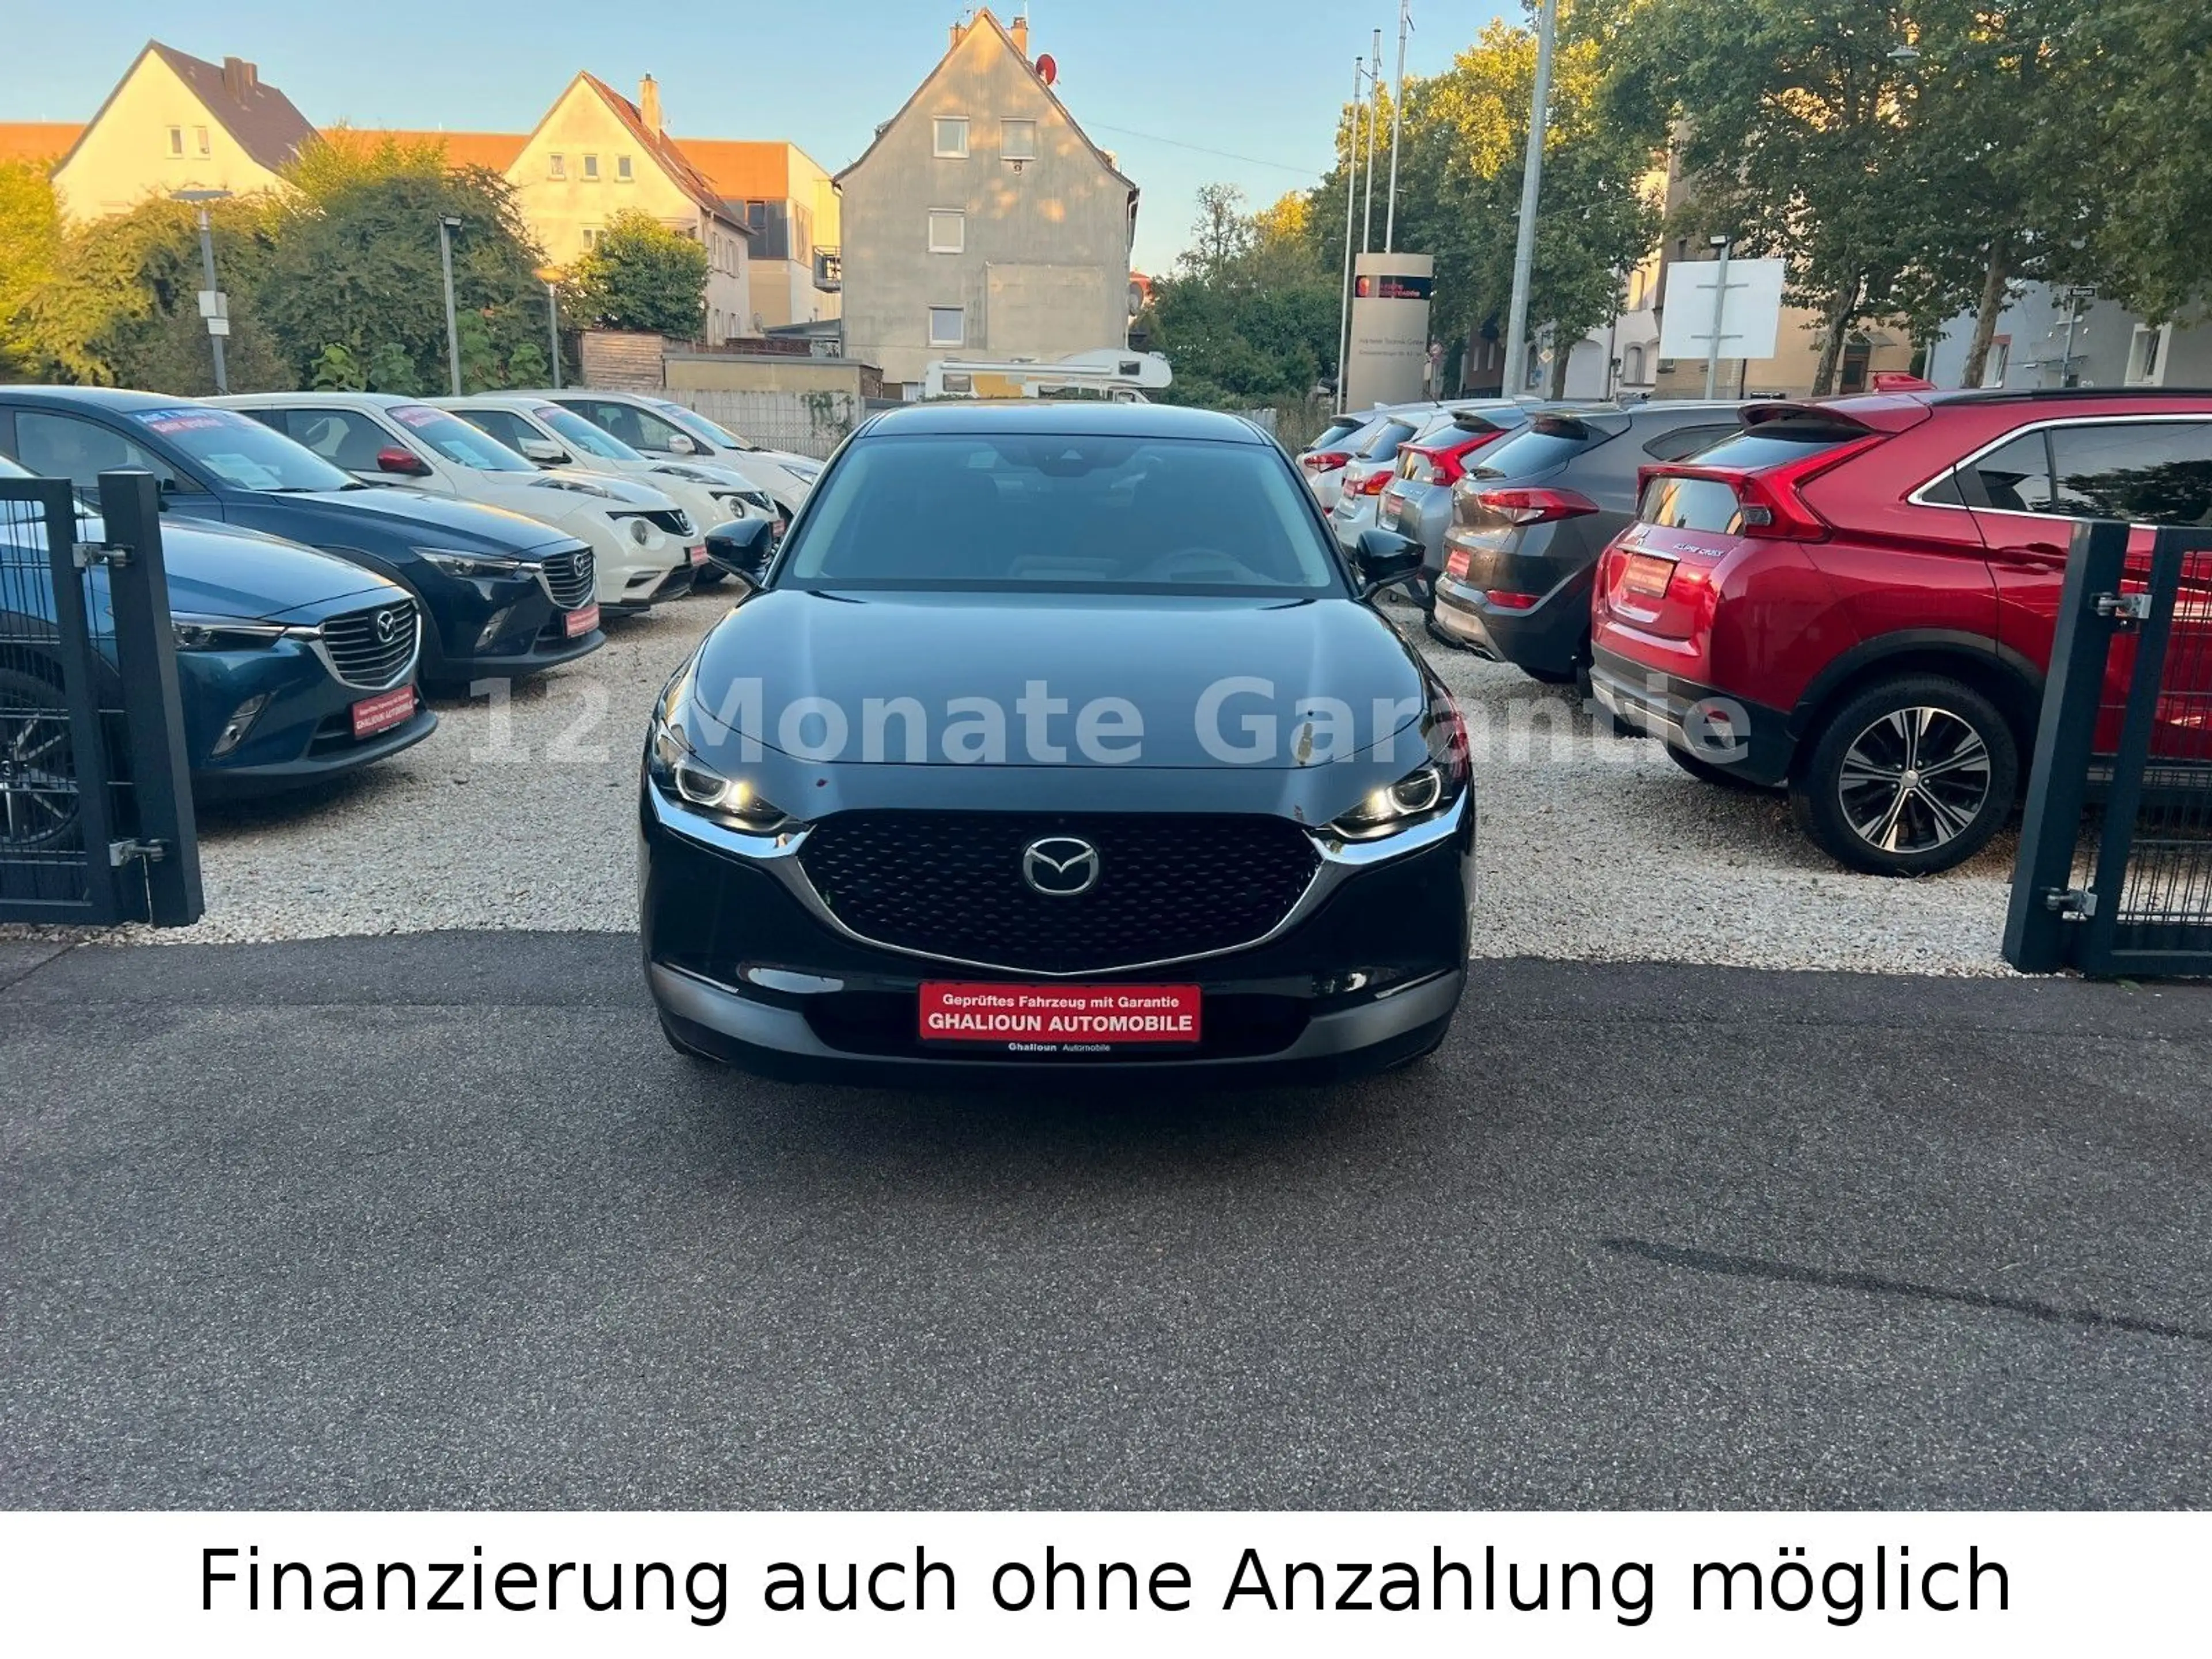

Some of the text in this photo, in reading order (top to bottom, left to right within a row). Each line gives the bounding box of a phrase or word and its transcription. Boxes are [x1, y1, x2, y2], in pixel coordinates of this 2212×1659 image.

[942, 994, 1179, 1010] Geprüftes Fahrzeug mit Garantie
[928, 1013, 1193, 1032] GHALIOUN AUTOMOBILE
[1008, 1042, 1111, 1052] Ghalioun Automobile
